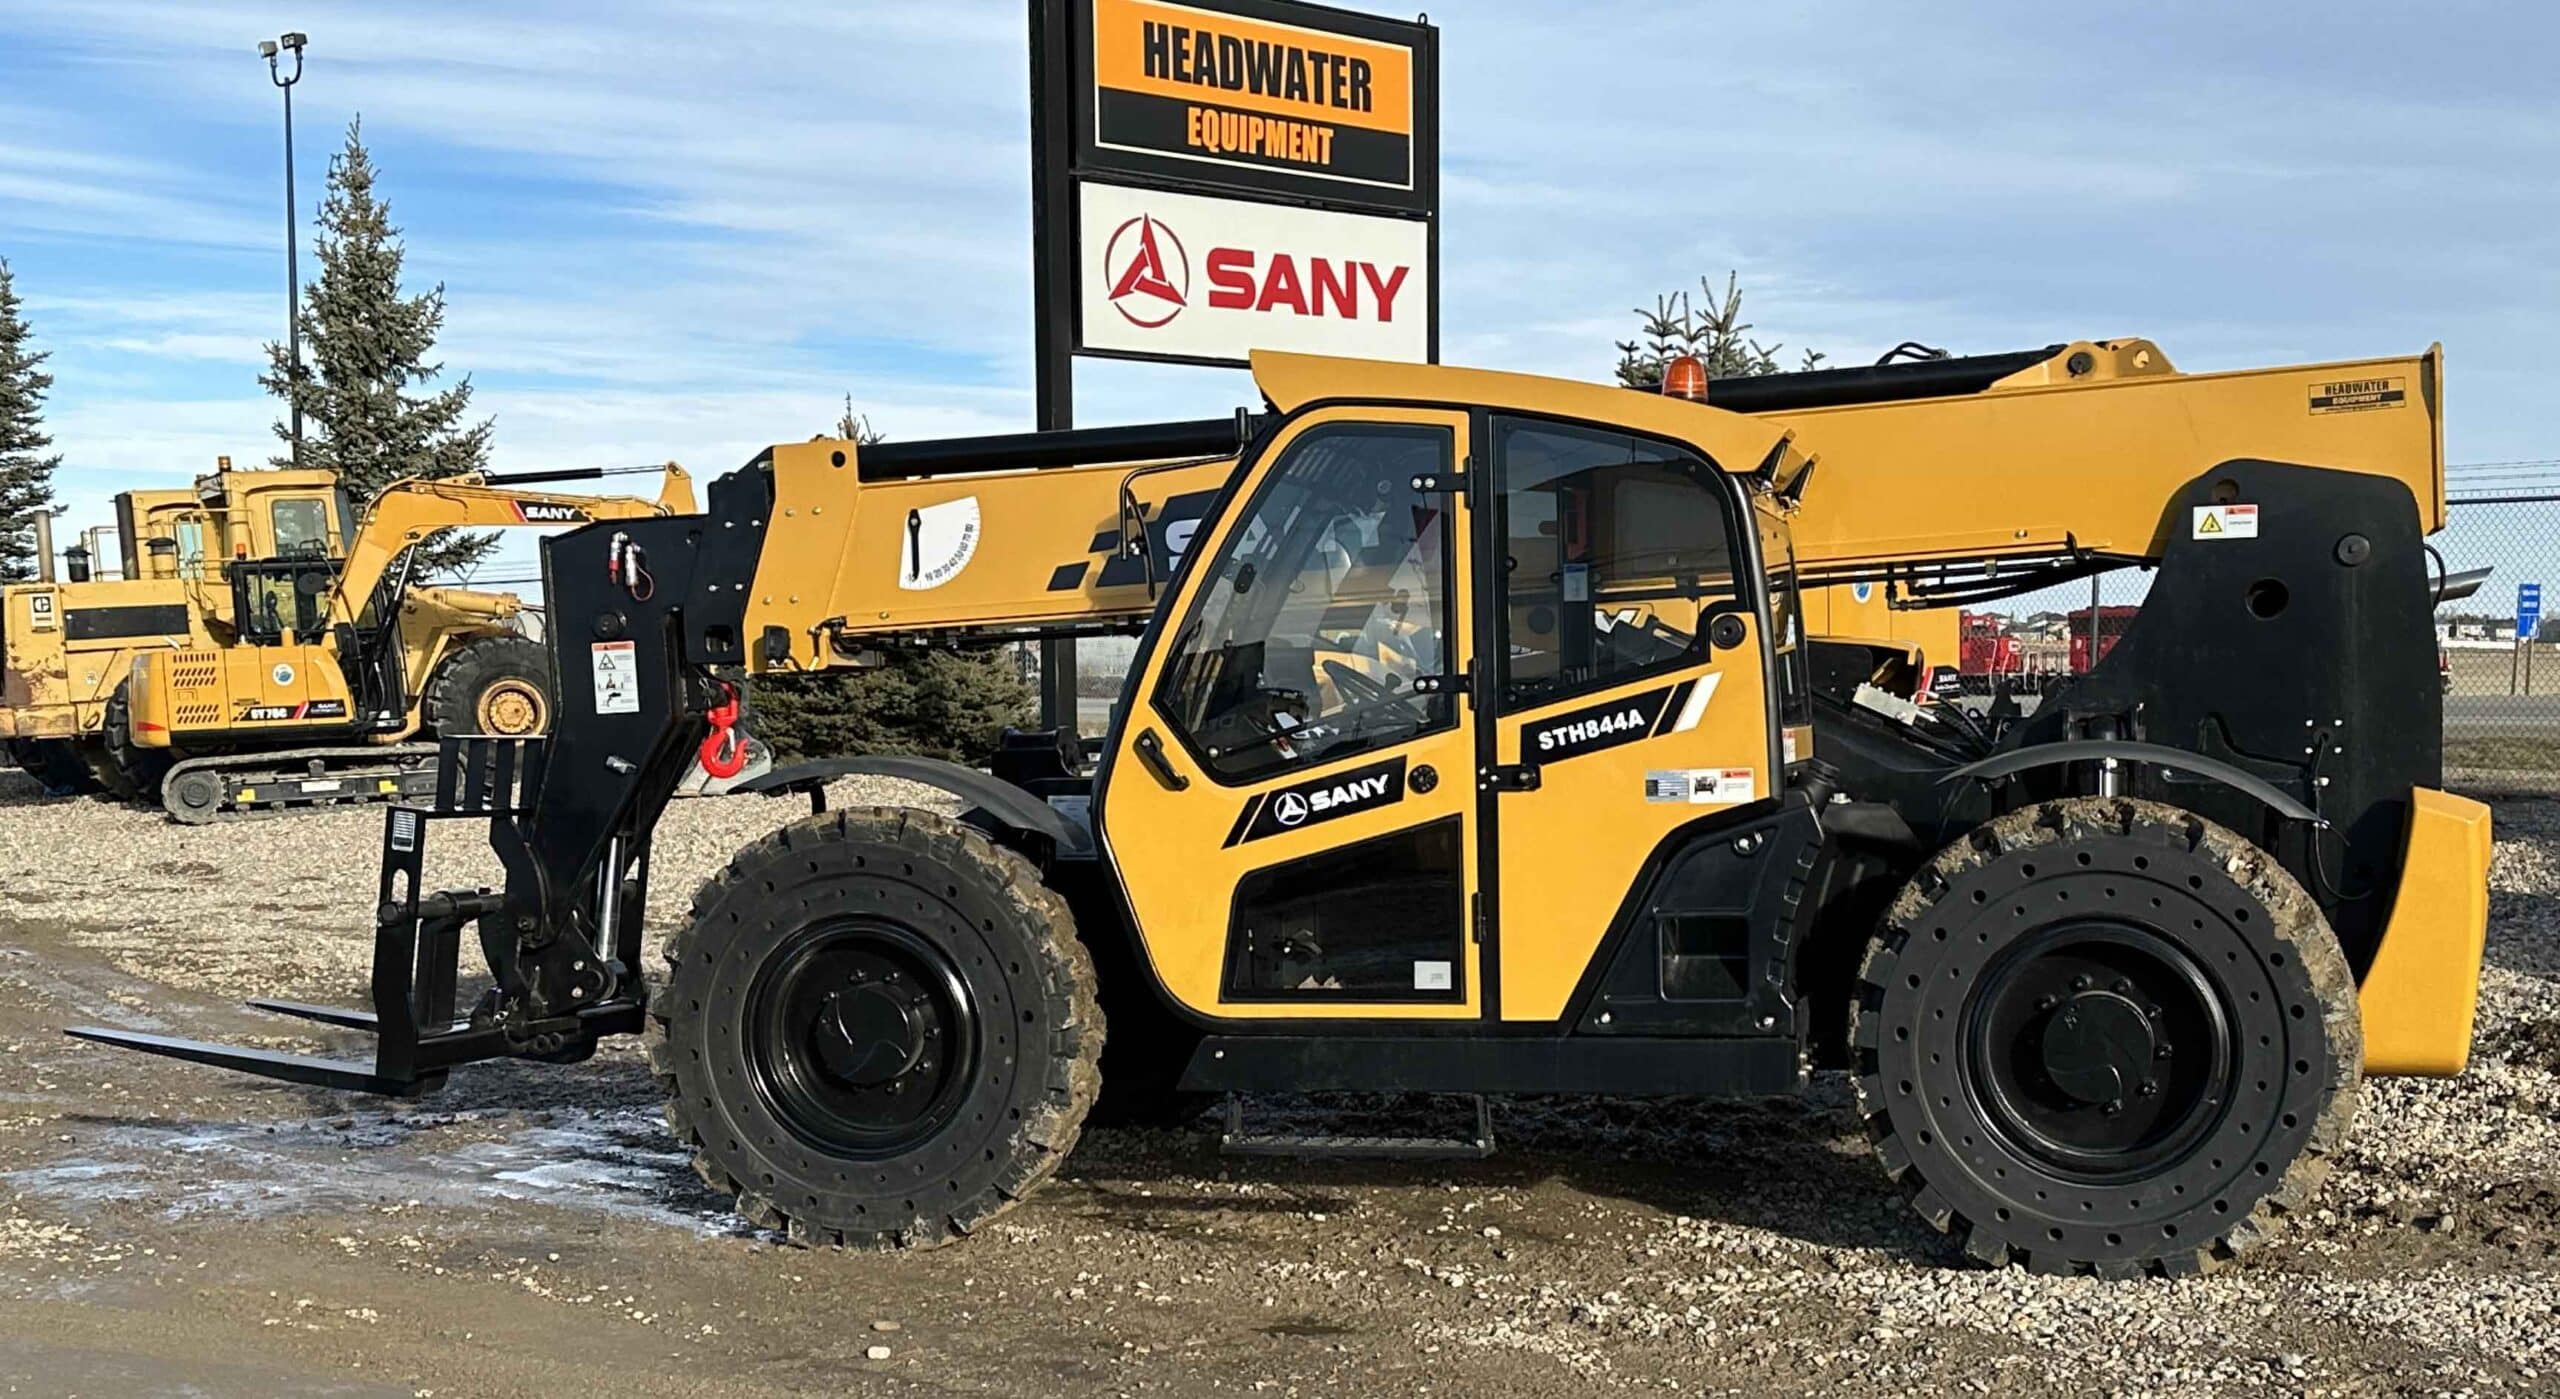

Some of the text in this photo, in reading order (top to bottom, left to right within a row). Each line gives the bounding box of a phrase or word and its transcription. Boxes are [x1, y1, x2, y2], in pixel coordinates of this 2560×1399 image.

[1143, 20, 1372, 113] HEADWATER
[1187, 106, 1334, 165] EQUIPMENT
[1206, 247, 1410, 322] SANY
[2325, 380, 2389, 396] HEADWATER
[525, 506, 576, 520] SANY
[1538, 708, 1645, 750] STH844A
[1309, 774, 1389, 812] SANY
